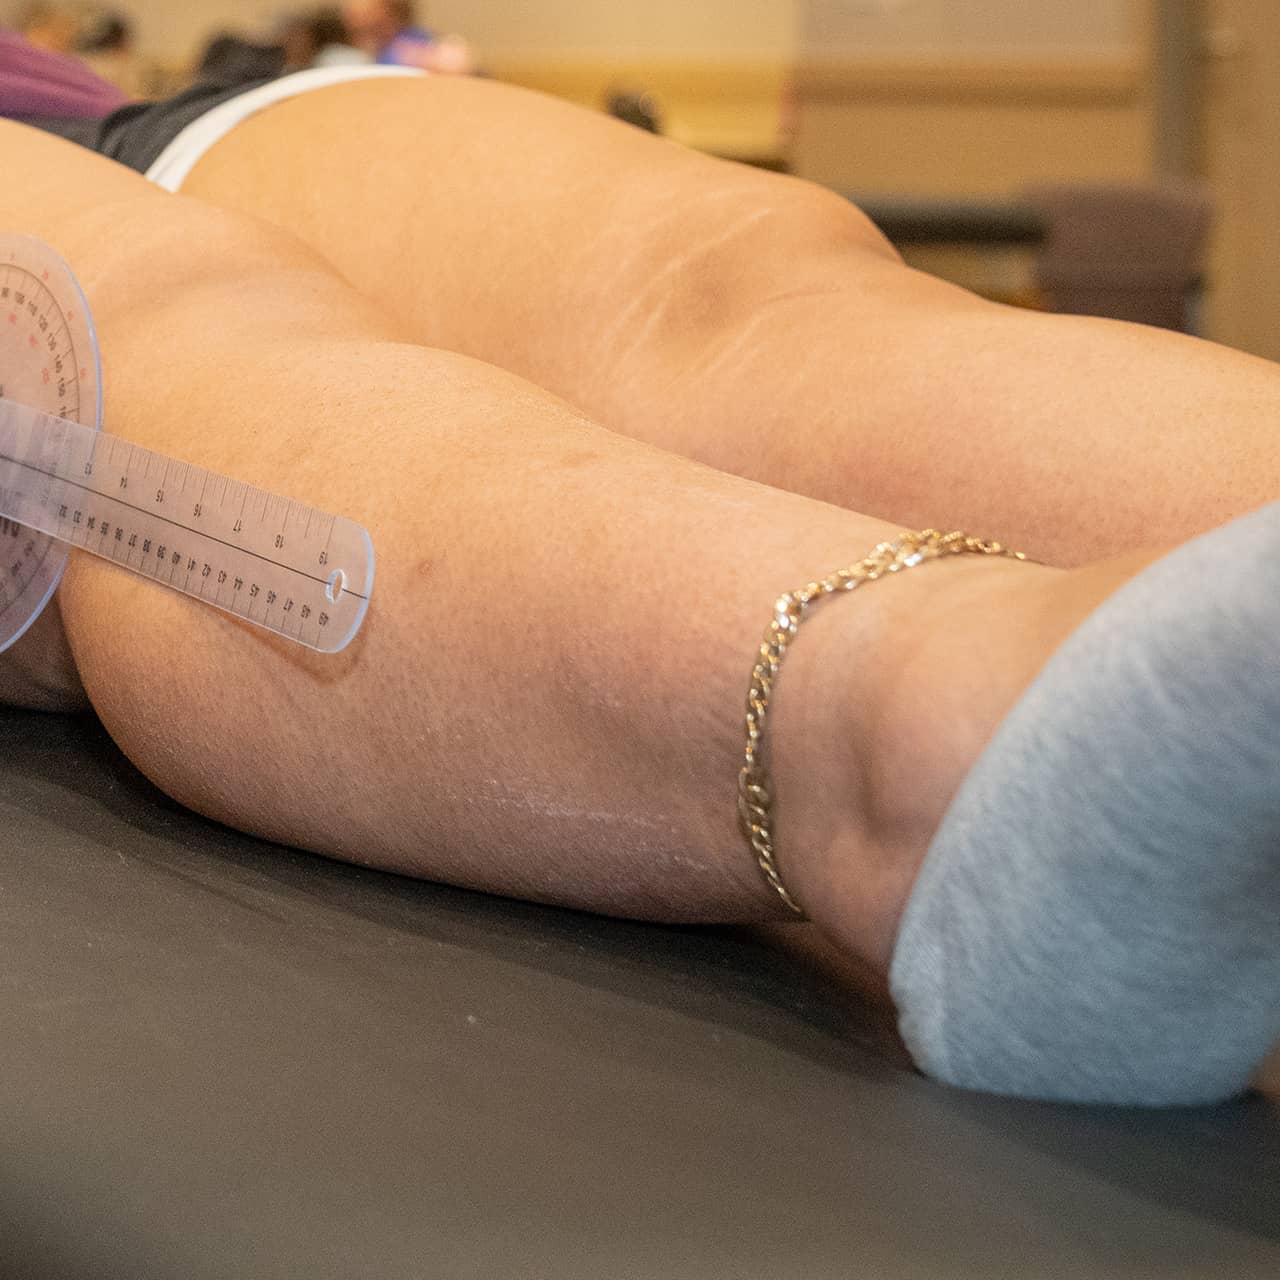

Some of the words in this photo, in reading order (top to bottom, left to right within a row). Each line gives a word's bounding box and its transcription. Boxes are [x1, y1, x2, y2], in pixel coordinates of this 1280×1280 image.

[84, 462, 93, 475] 13
[120, 476, 128, 488] 14
[156, 489, 164, 503] 15
[193, 504, 202, 517] 16
[233, 519, 242, 532] 17
[275, 534, 284, 549] 18
[319, 551, 328, 565] 19
